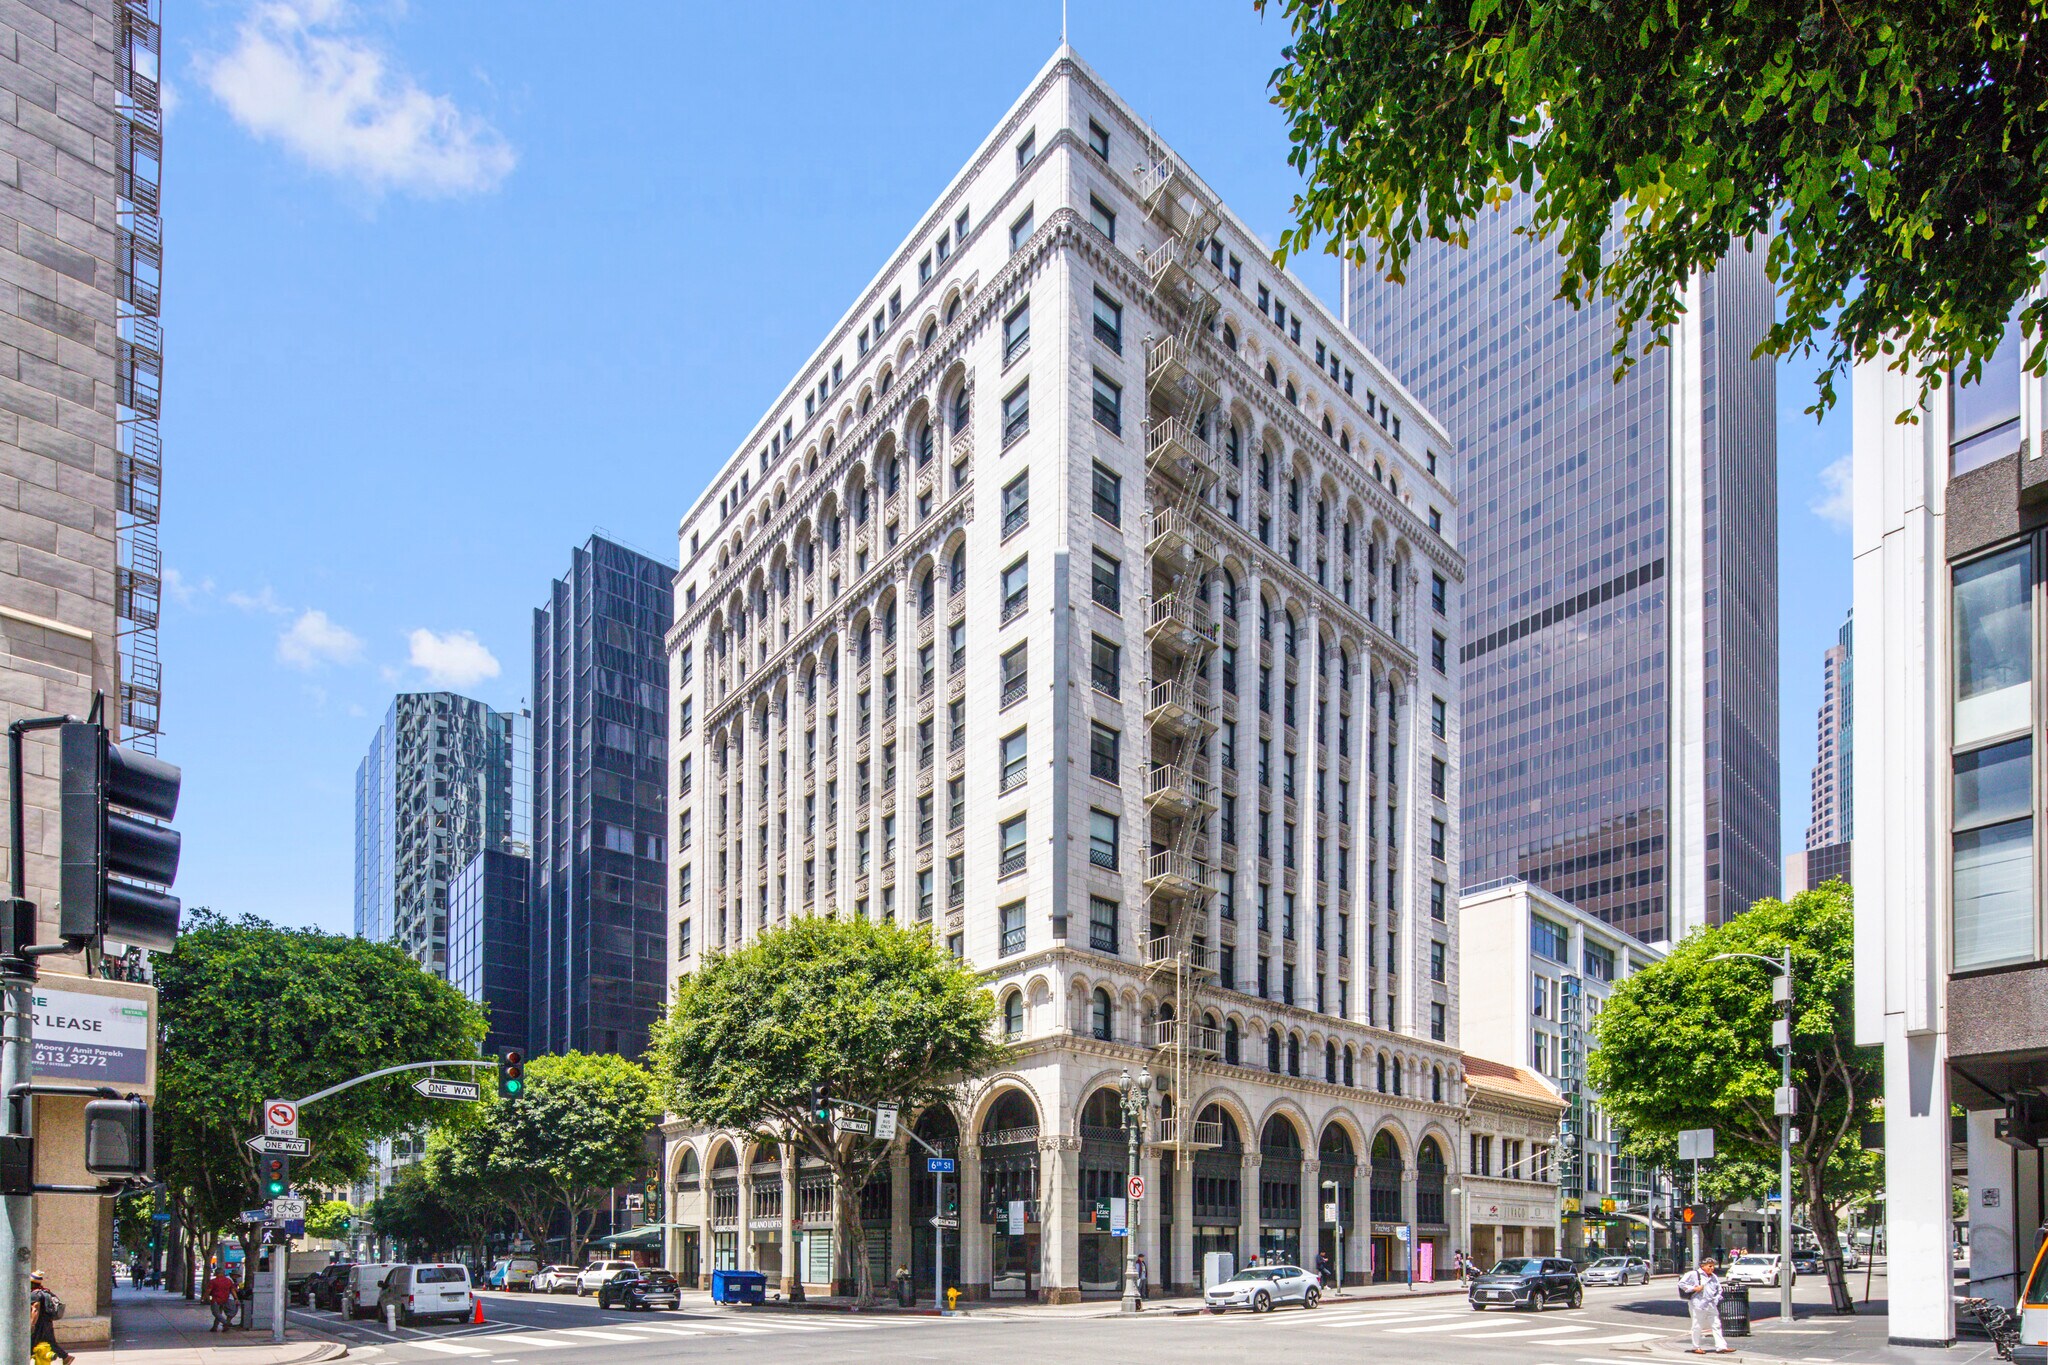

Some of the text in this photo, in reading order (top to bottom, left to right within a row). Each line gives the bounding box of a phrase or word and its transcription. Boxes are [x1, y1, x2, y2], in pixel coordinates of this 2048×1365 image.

[32, 997, 47, 1007] RE
[46, 1015, 102, 1032] LEASE
[35, 1043, 64, 1052] Moore
[72, 1046, 93, 1054] Amit
[94, 1048, 124, 1057] Parekh
[35, 1051, 65, 1063] 613
[69, 1053, 107, 1067] 3272
[428, 1083, 473, 1095] ONE WAY
[841, 1121, 852, 1129] ONE
[265, 1141, 283, 1149] ONE
[931, 1161, 942, 1169] 6th
[749, 1220, 782, 1229] MILANO LOFTS
[1375, 1224, 1390, 1232] Pinches
